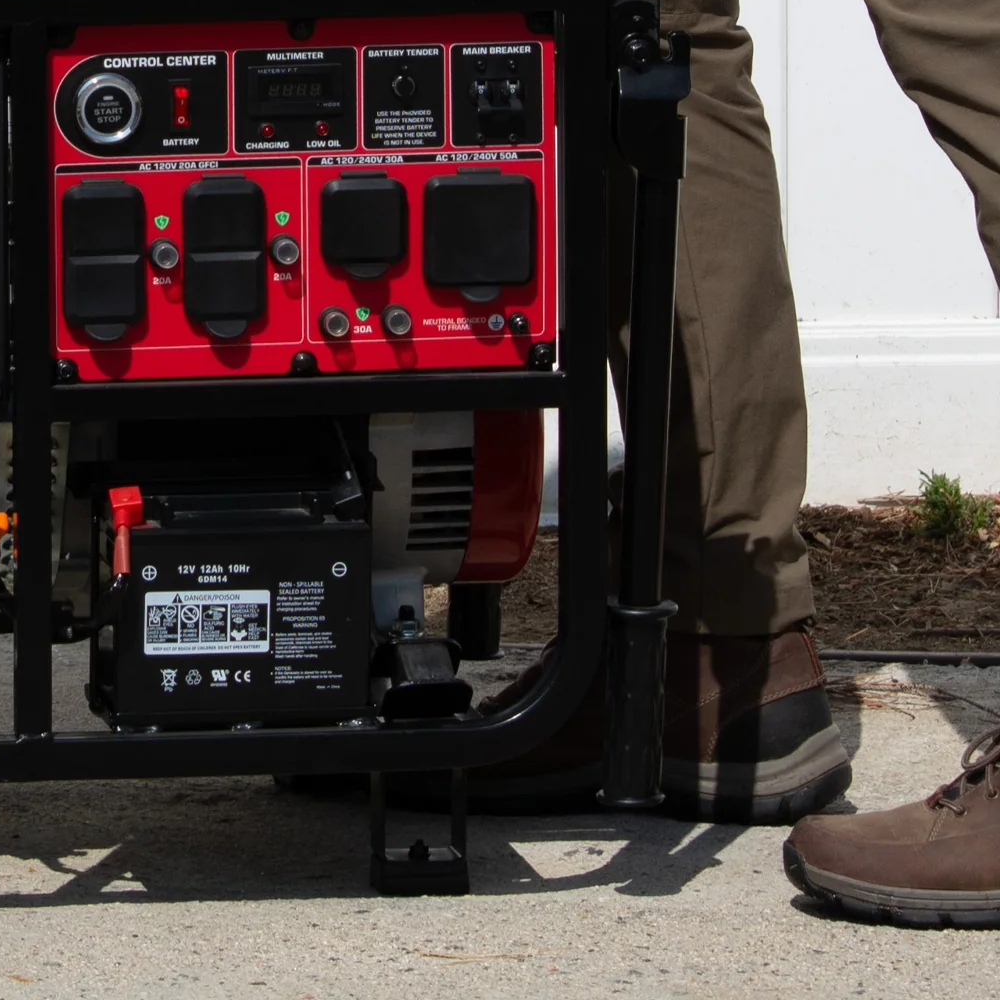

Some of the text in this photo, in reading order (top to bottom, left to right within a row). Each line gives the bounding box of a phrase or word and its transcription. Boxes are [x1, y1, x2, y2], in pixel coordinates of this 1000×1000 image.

[490, 46, 531, 54] BREAKER
[267, 52, 323, 60] MULTIMETER
[104, 55, 216, 68] CONTROL CENTER
[163, 138, 199, 146] BATTERY
[246, 142, 289, 150] CHARGING
[336, 156, 382, 164] 120/240V
[385, 155, 403, 163] 30A
[436, 152, 518, 162] AC 120/240V 50A
[139, 161, 218, 171] AC 120V 20A GFCI
[153, 277, 171, 285] 20A
[273, 273, 292, 281] 20A
[354, 325, 372, 333] 30A
[178, 565, 250, 574] 12V 12Ah 10Hr
